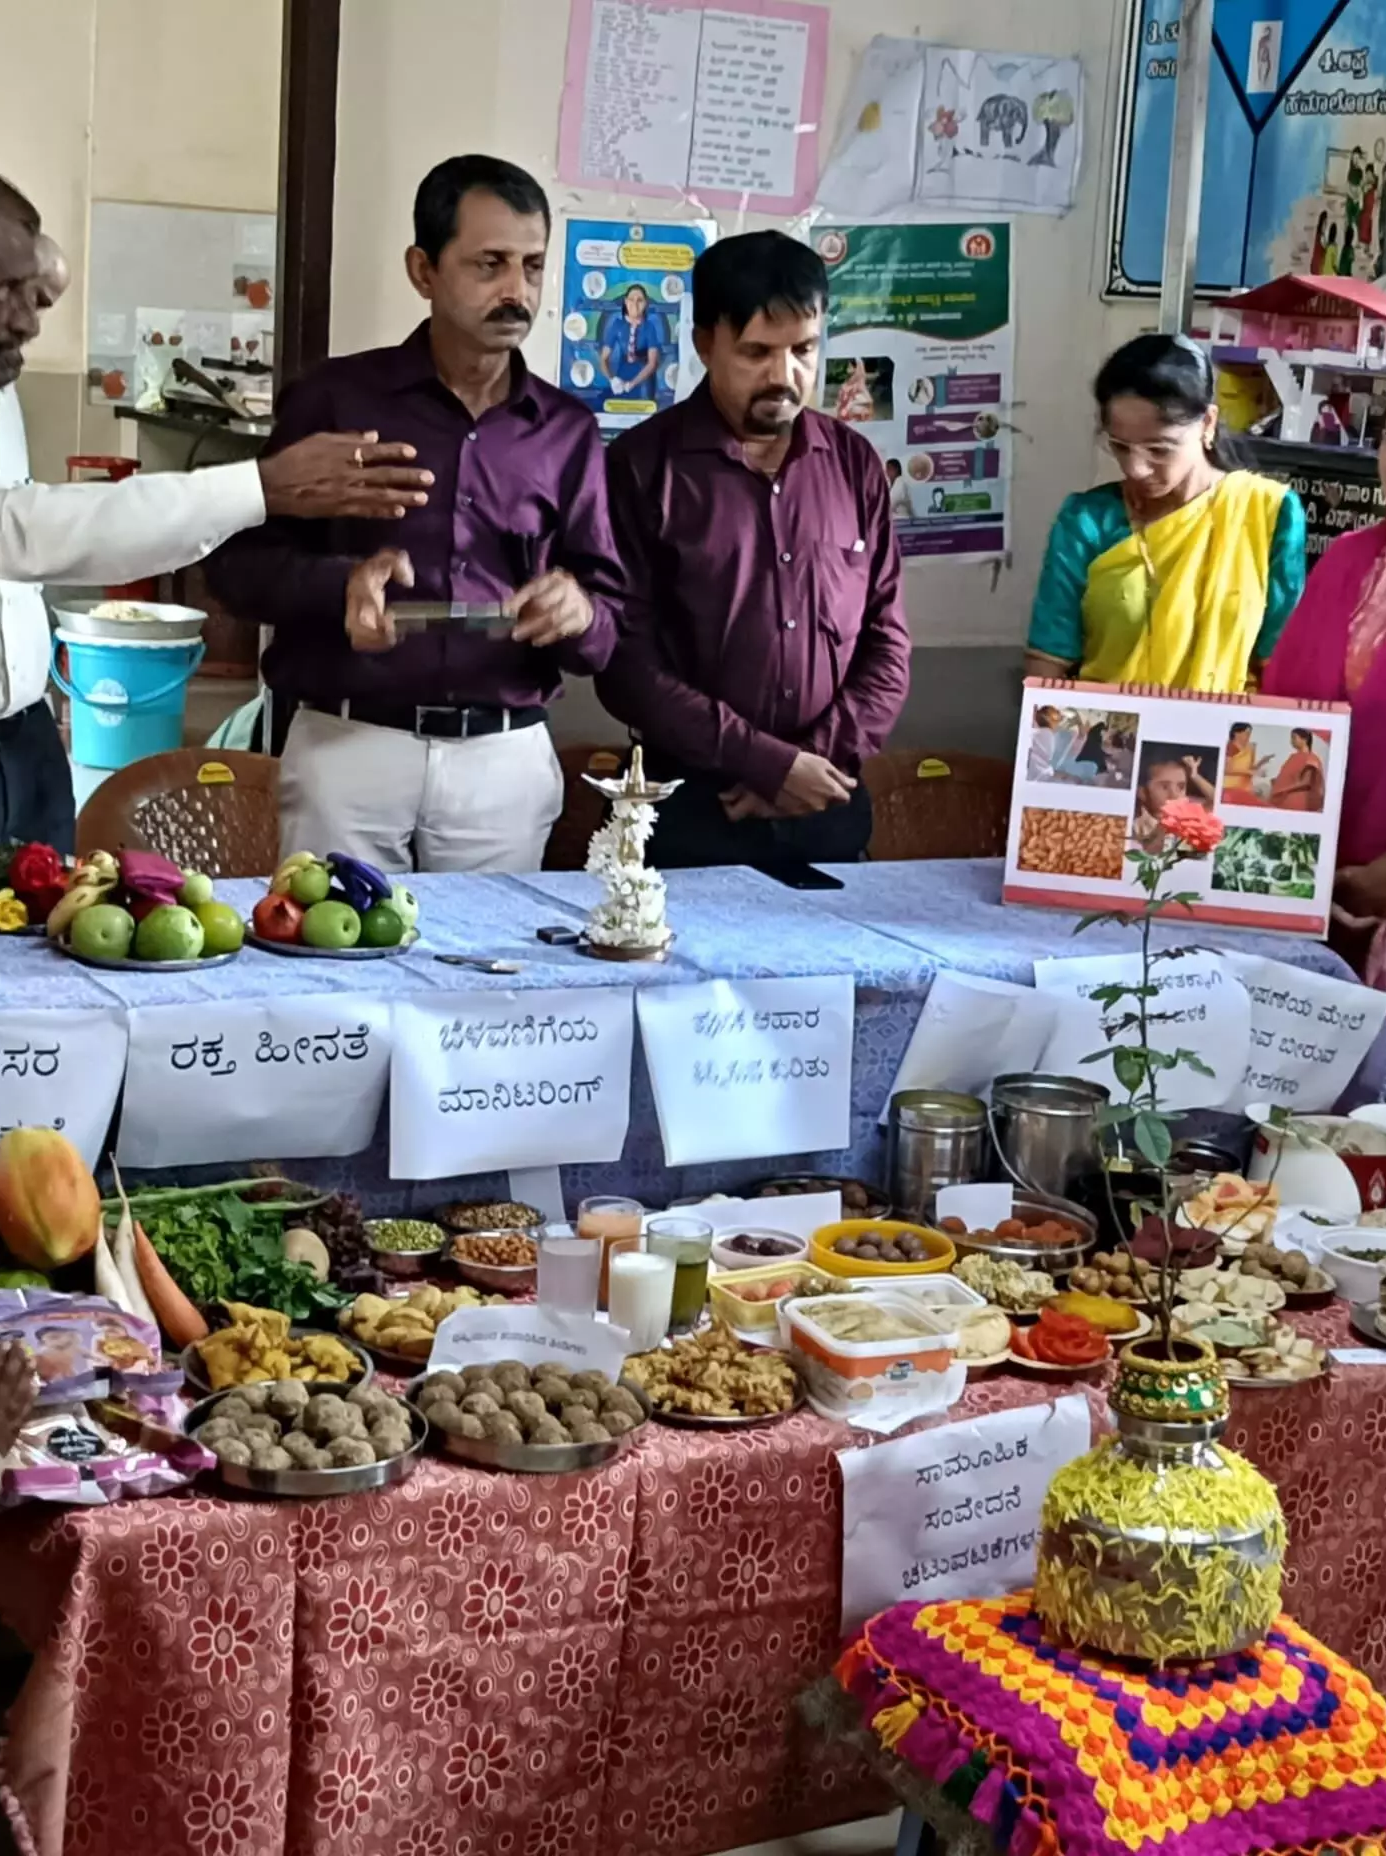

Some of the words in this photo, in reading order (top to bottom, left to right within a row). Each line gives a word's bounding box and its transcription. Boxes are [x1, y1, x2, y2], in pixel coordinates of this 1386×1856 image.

[439, 1015, 598, 1050] ಬೆಳವಣಿಗೆಯ
[753, 1005, 820, 1031] ಆಹಾರ
[1317, 1005, 1365, 1030] ಮೇಲೆ
[171, 1033, 237, 1076] ರಕ್ತ
[255, 1023, 370, 1064] ಹೀನತೆ
[438, 1075, 603, 1113] ಮಾನಿಟರಿಂಗ್
[916, 1434, 1029, 1486] ಸಾಮೂಹಿಕ
[924, 1485, 1022, 1531] ಸಂವೇದನೆ
[902, 1527, 1043, 1589] ಚಟುವಟಿಕೆಗಳ
